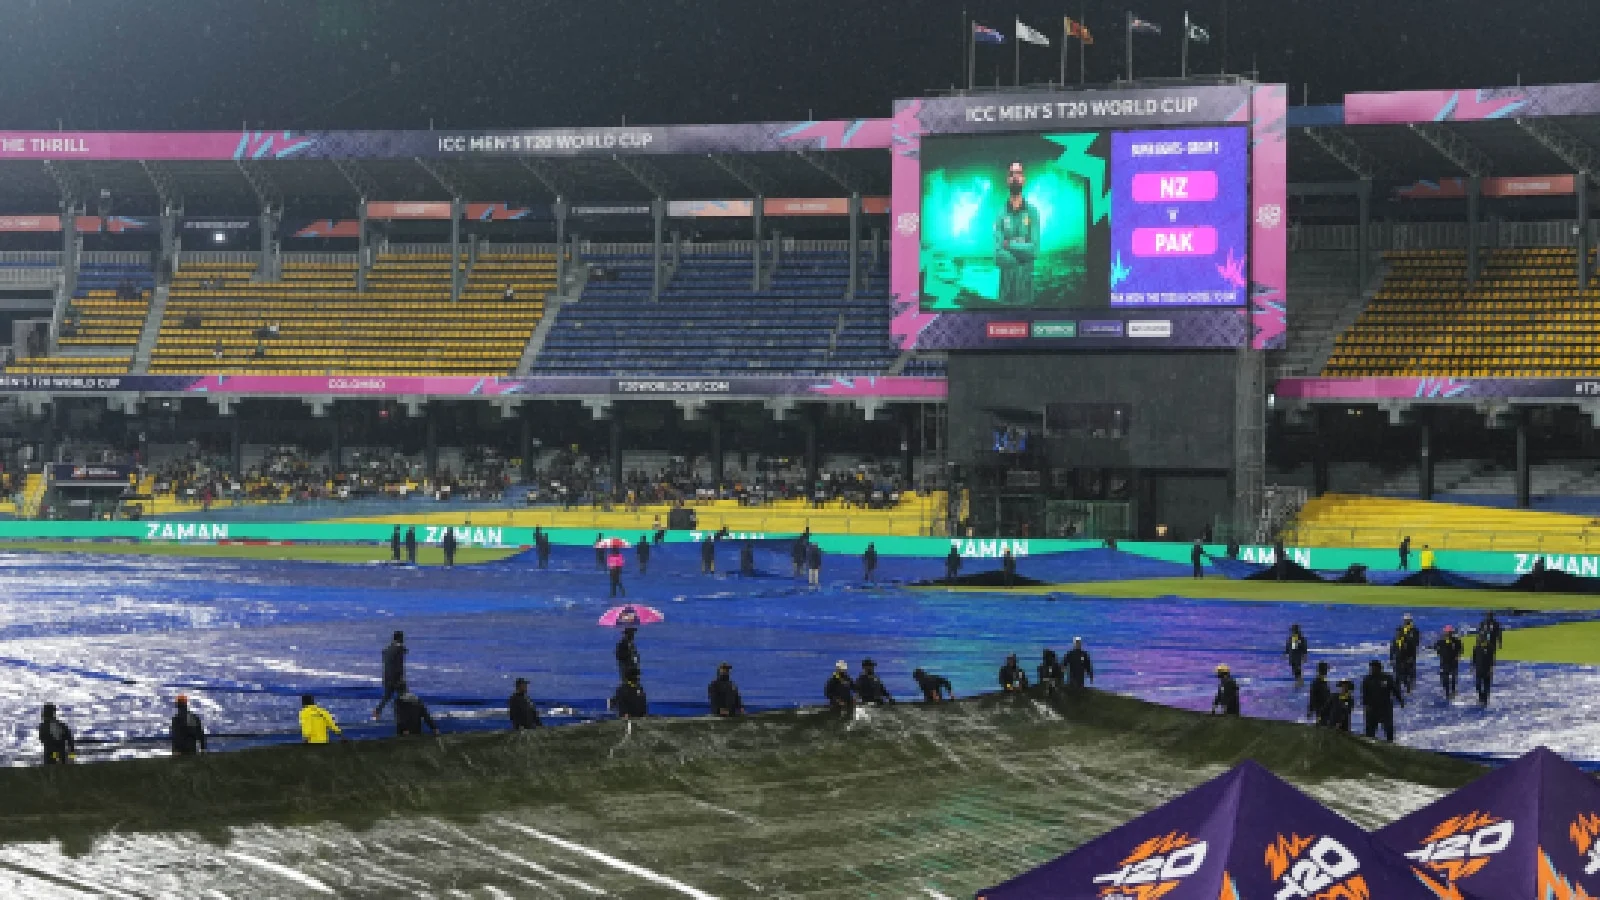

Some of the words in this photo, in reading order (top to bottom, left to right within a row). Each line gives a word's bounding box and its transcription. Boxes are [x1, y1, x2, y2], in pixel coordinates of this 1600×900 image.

[966, 106, 996, 121] ICC
[999, 103, 1052, 121] MEN'S
[1057, 102, 1088, 118] T20
[1090, 99, 1157, 116] WORLD
[1161, 97, 1198, 112] CUP
[0, 139, 25, 151] HE
[30, 138, 89, 151] THRILL
[438, 136, 466, 151] ICC
[471, 136, 520, 149] MEN'S
[524, 135, 551, 149] T20
[556, 133, 614, 148] WORLD
[619, 132, 652, 146] CUP
[1160, 176, 1188, 198] NZ
[1155, 232, 1194, 252] PAK
[145, 522, 228, 539] ZAMAN
